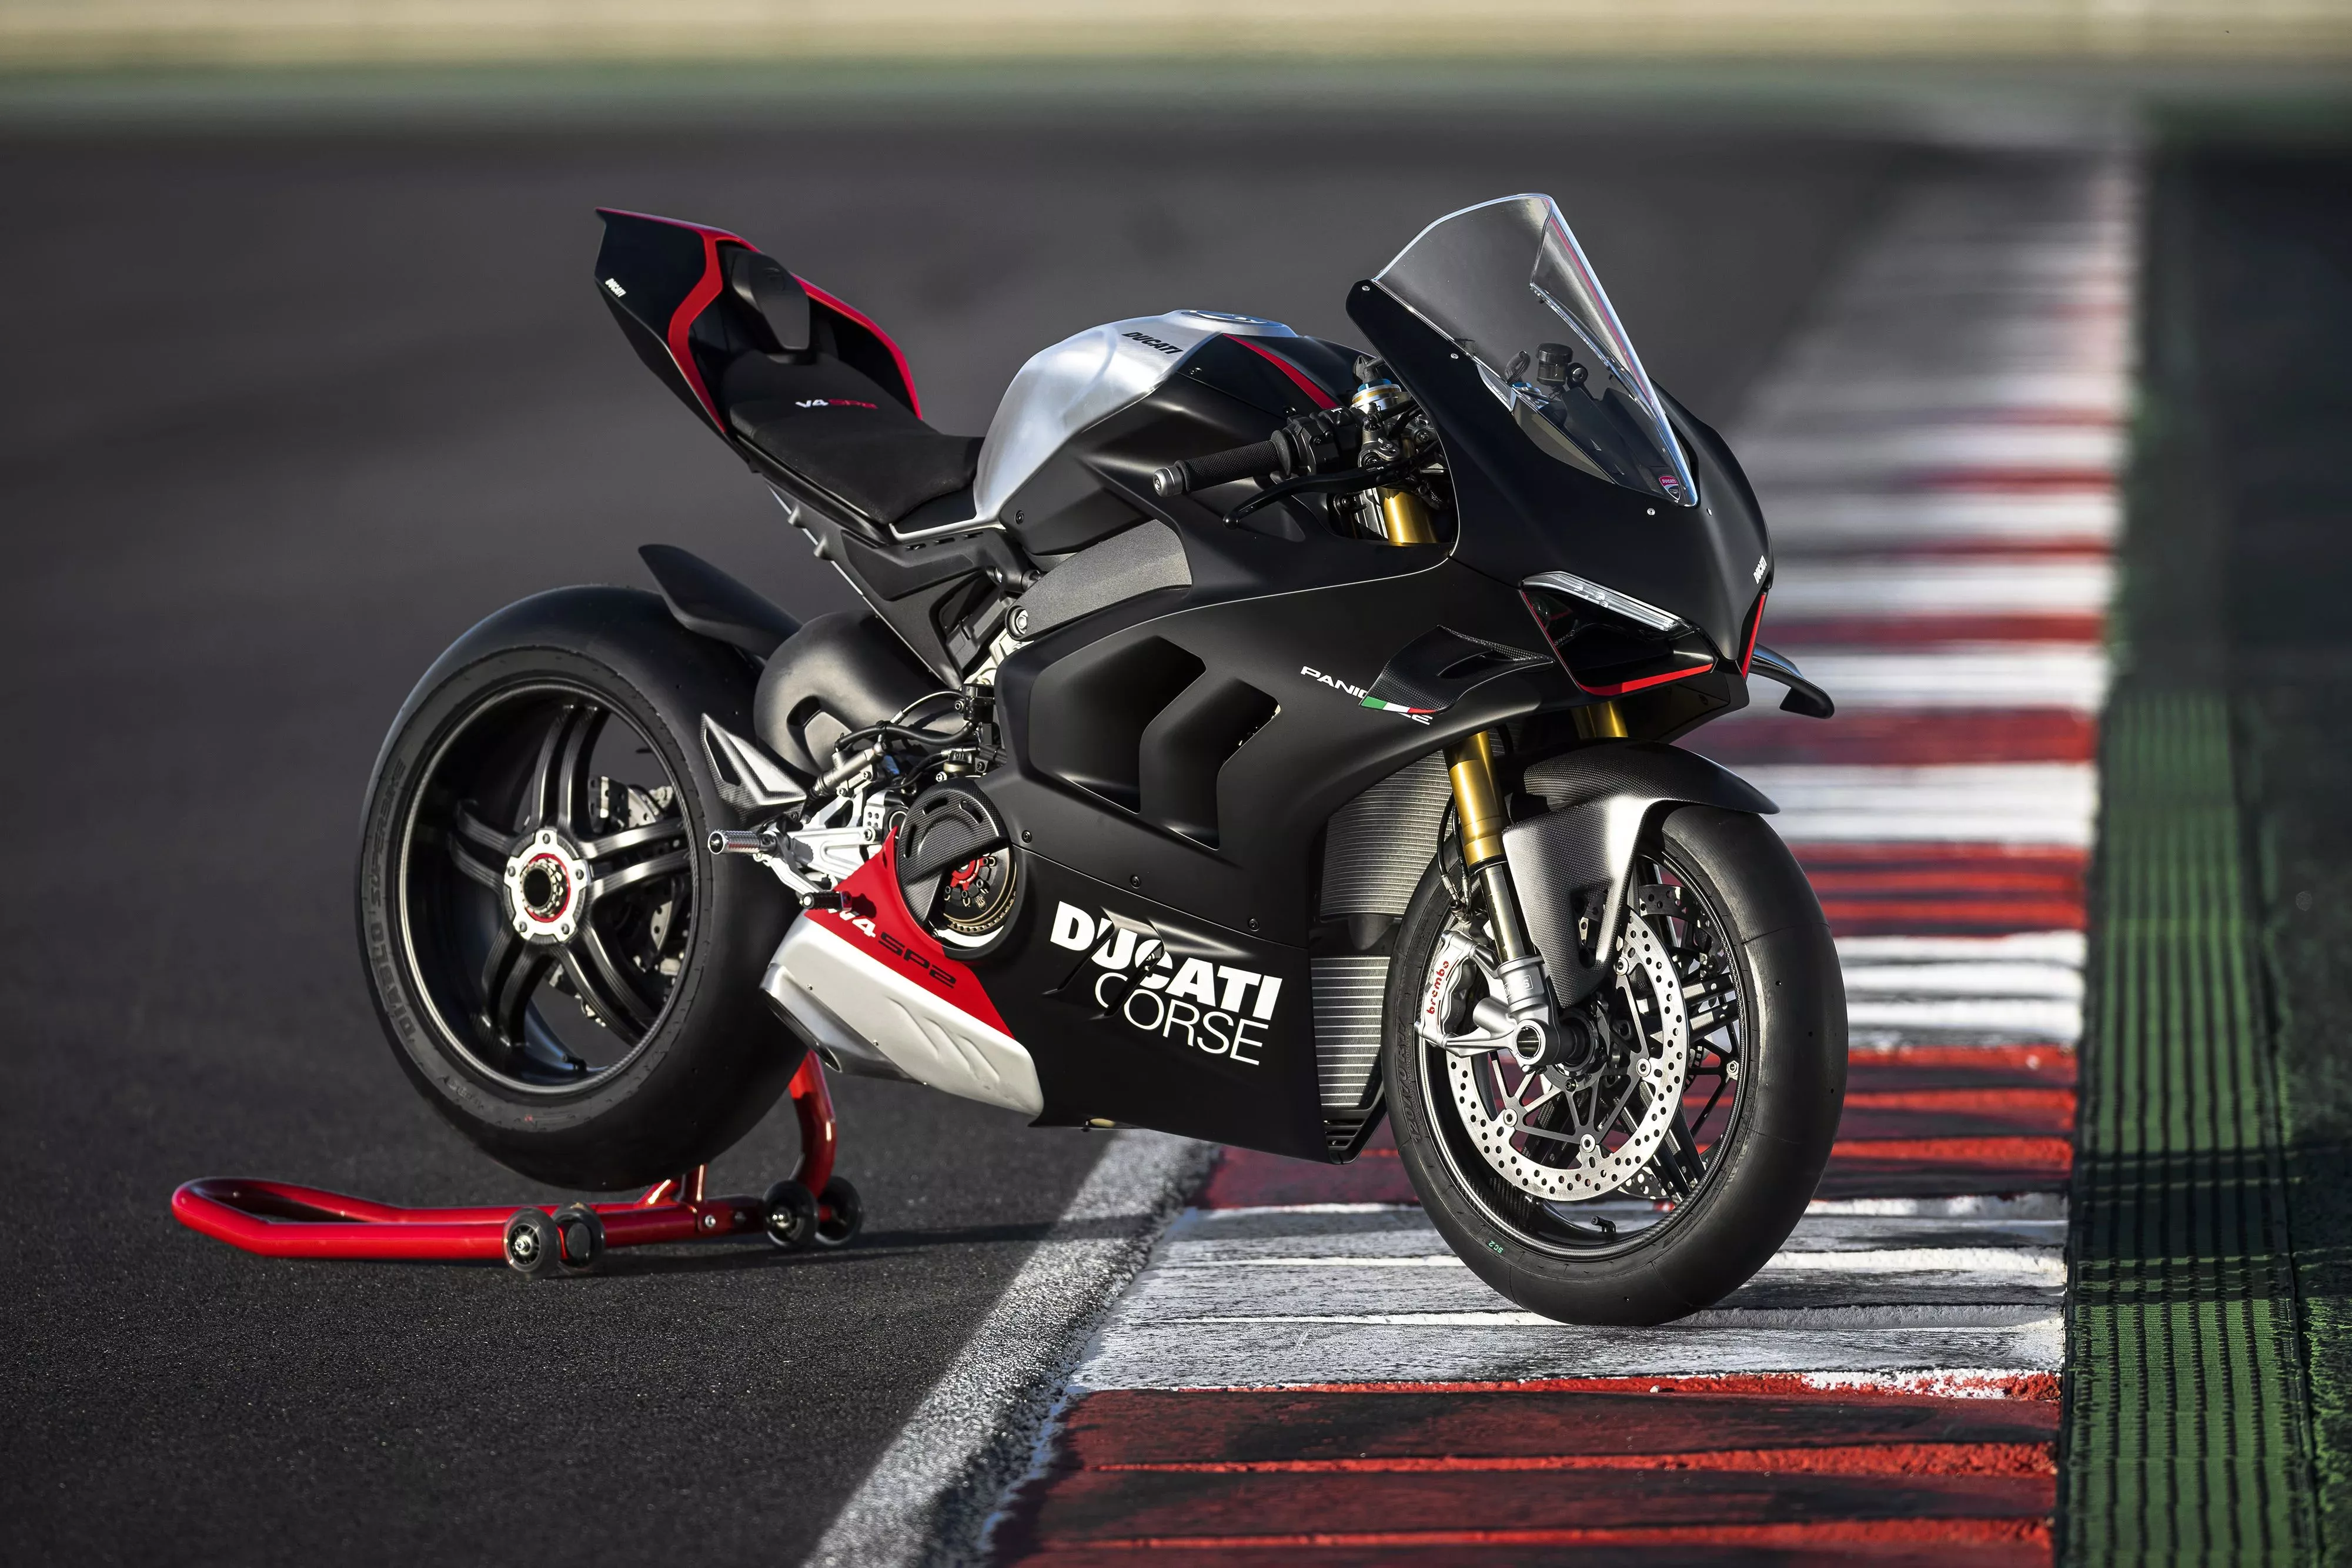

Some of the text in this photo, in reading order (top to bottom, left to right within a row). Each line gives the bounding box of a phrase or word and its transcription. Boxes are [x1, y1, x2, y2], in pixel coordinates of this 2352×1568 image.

[1121, 332, 1184, 354] DUCATI
[370, 923, 416, 1038] DIABLO
[878, 932, 957, 989] SP2
[1050, 901, 1282, 1021] DUCATI
[1426, 961, 1449, 1014] brembo
[1095, 972, 1269, 1065] CORSE
[1488, 1241, 1504, 1253] SC2
